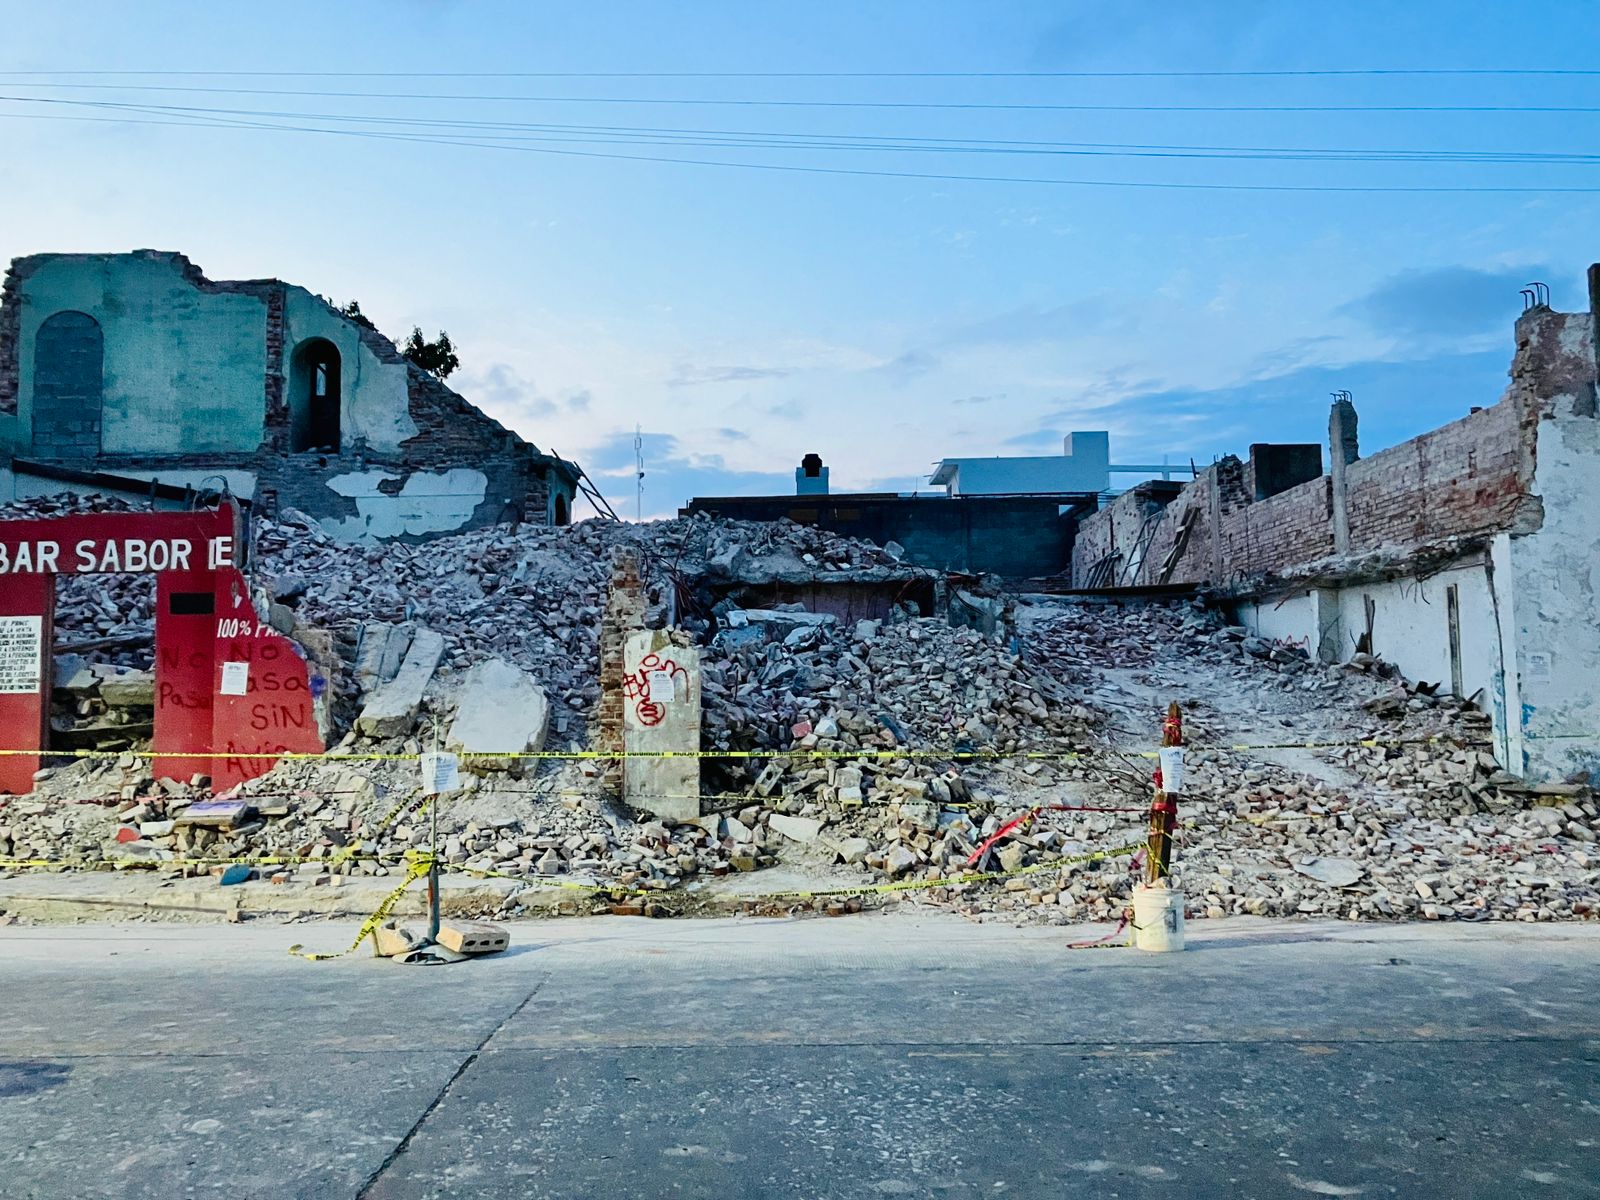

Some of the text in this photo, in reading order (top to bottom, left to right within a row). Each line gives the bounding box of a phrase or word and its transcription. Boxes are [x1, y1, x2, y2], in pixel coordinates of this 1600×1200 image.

[75, 539, 193, 573] SABOR
[217, 618, 252, 638] 100%
[230, 642, 278, 662] NO
[247, 672, 307, 693] asa
